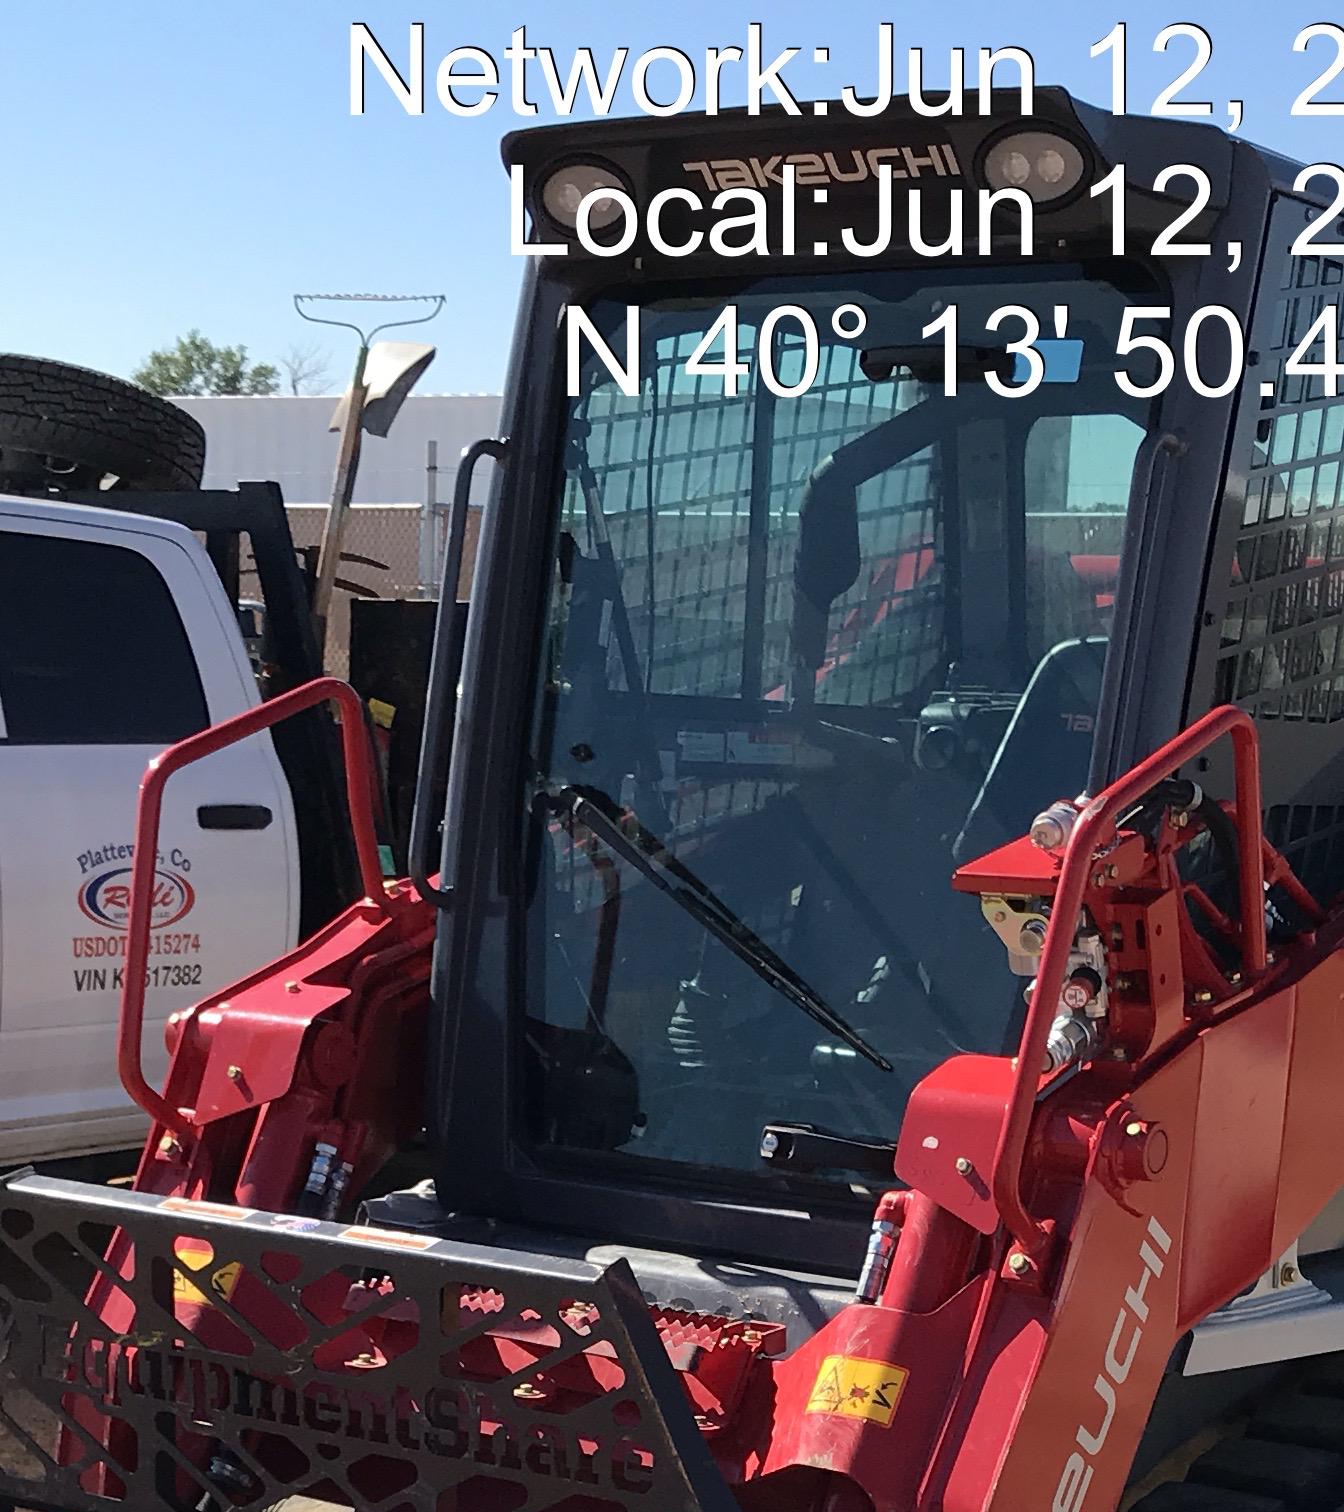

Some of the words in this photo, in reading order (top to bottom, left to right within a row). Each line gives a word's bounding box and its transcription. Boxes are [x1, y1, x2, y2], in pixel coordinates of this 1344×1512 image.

[682, 143, 961, 192] TAKEUCHI
[170, 848, 192, 872] Co
[73, 935, 128, 958] USDOT
[74, 967, 106, 992] VIN
[112, 963, 202, 990] K517382
